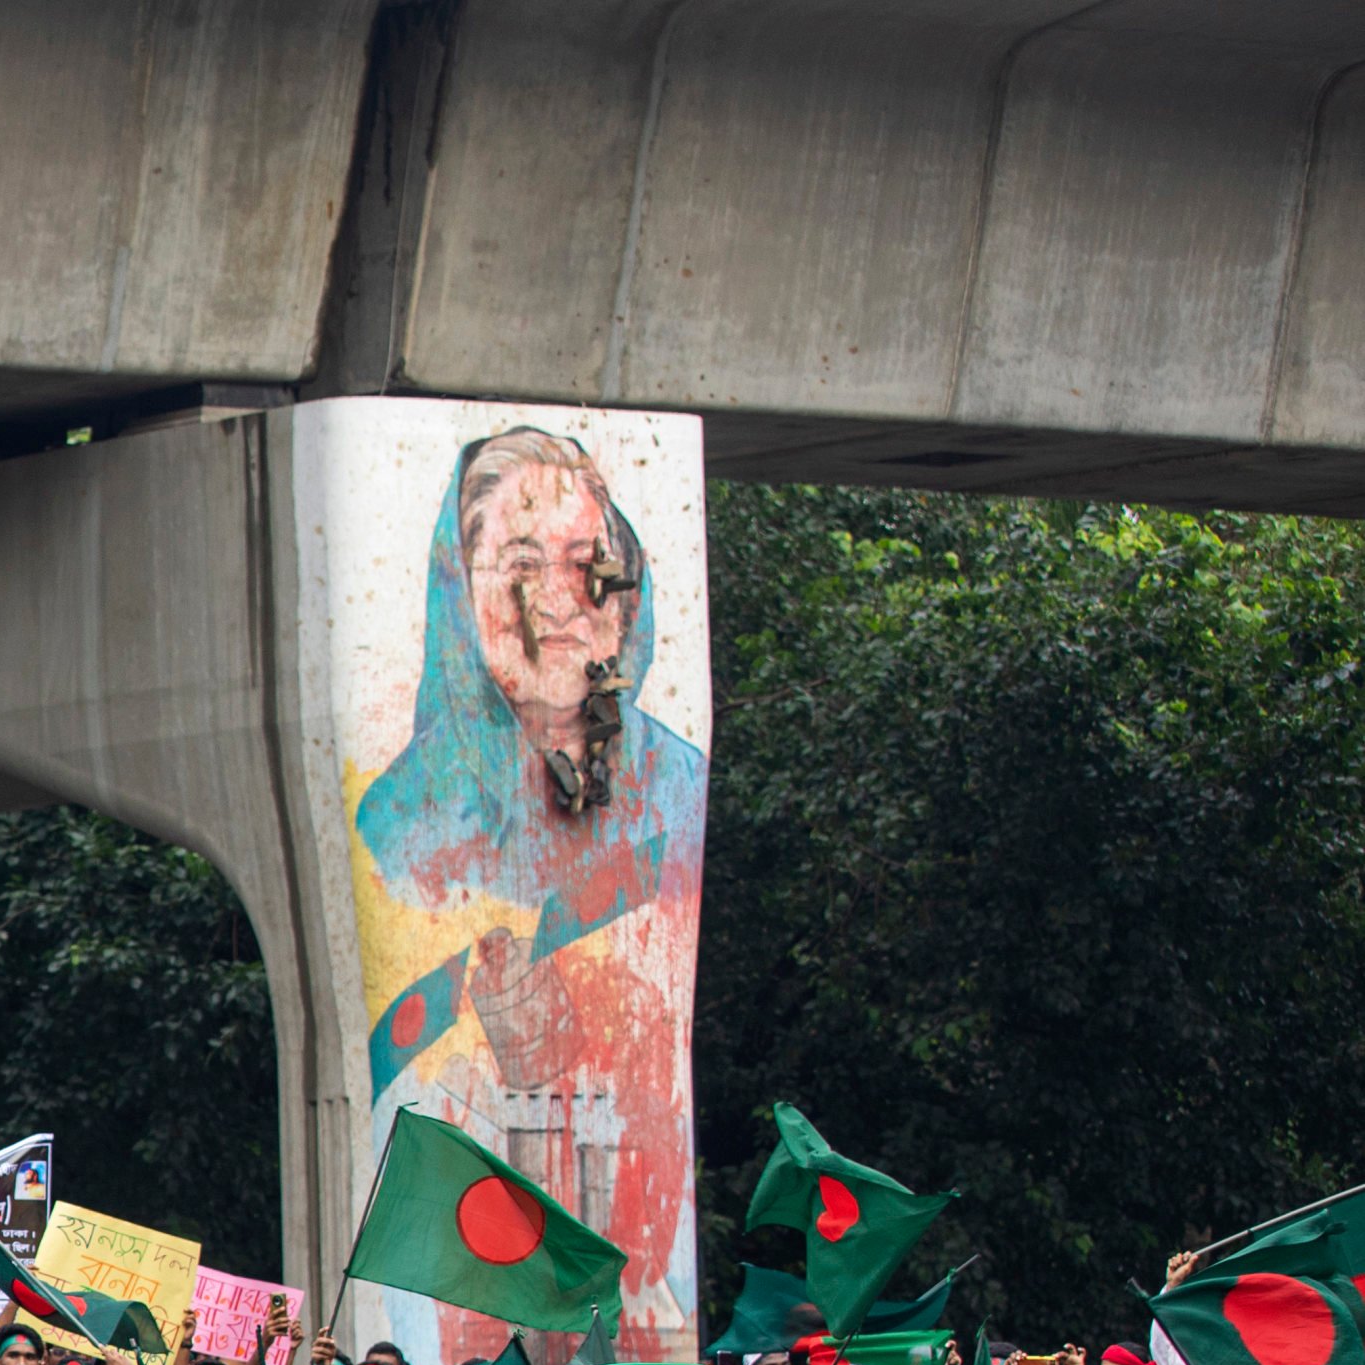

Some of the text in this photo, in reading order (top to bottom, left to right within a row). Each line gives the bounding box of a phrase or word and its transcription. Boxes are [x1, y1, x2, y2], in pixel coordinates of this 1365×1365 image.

[97, 1226, 153, 1265] নতুন
[152, 1243, 197, 1278] দল
[78, 1254, 160, 1302] বানান
